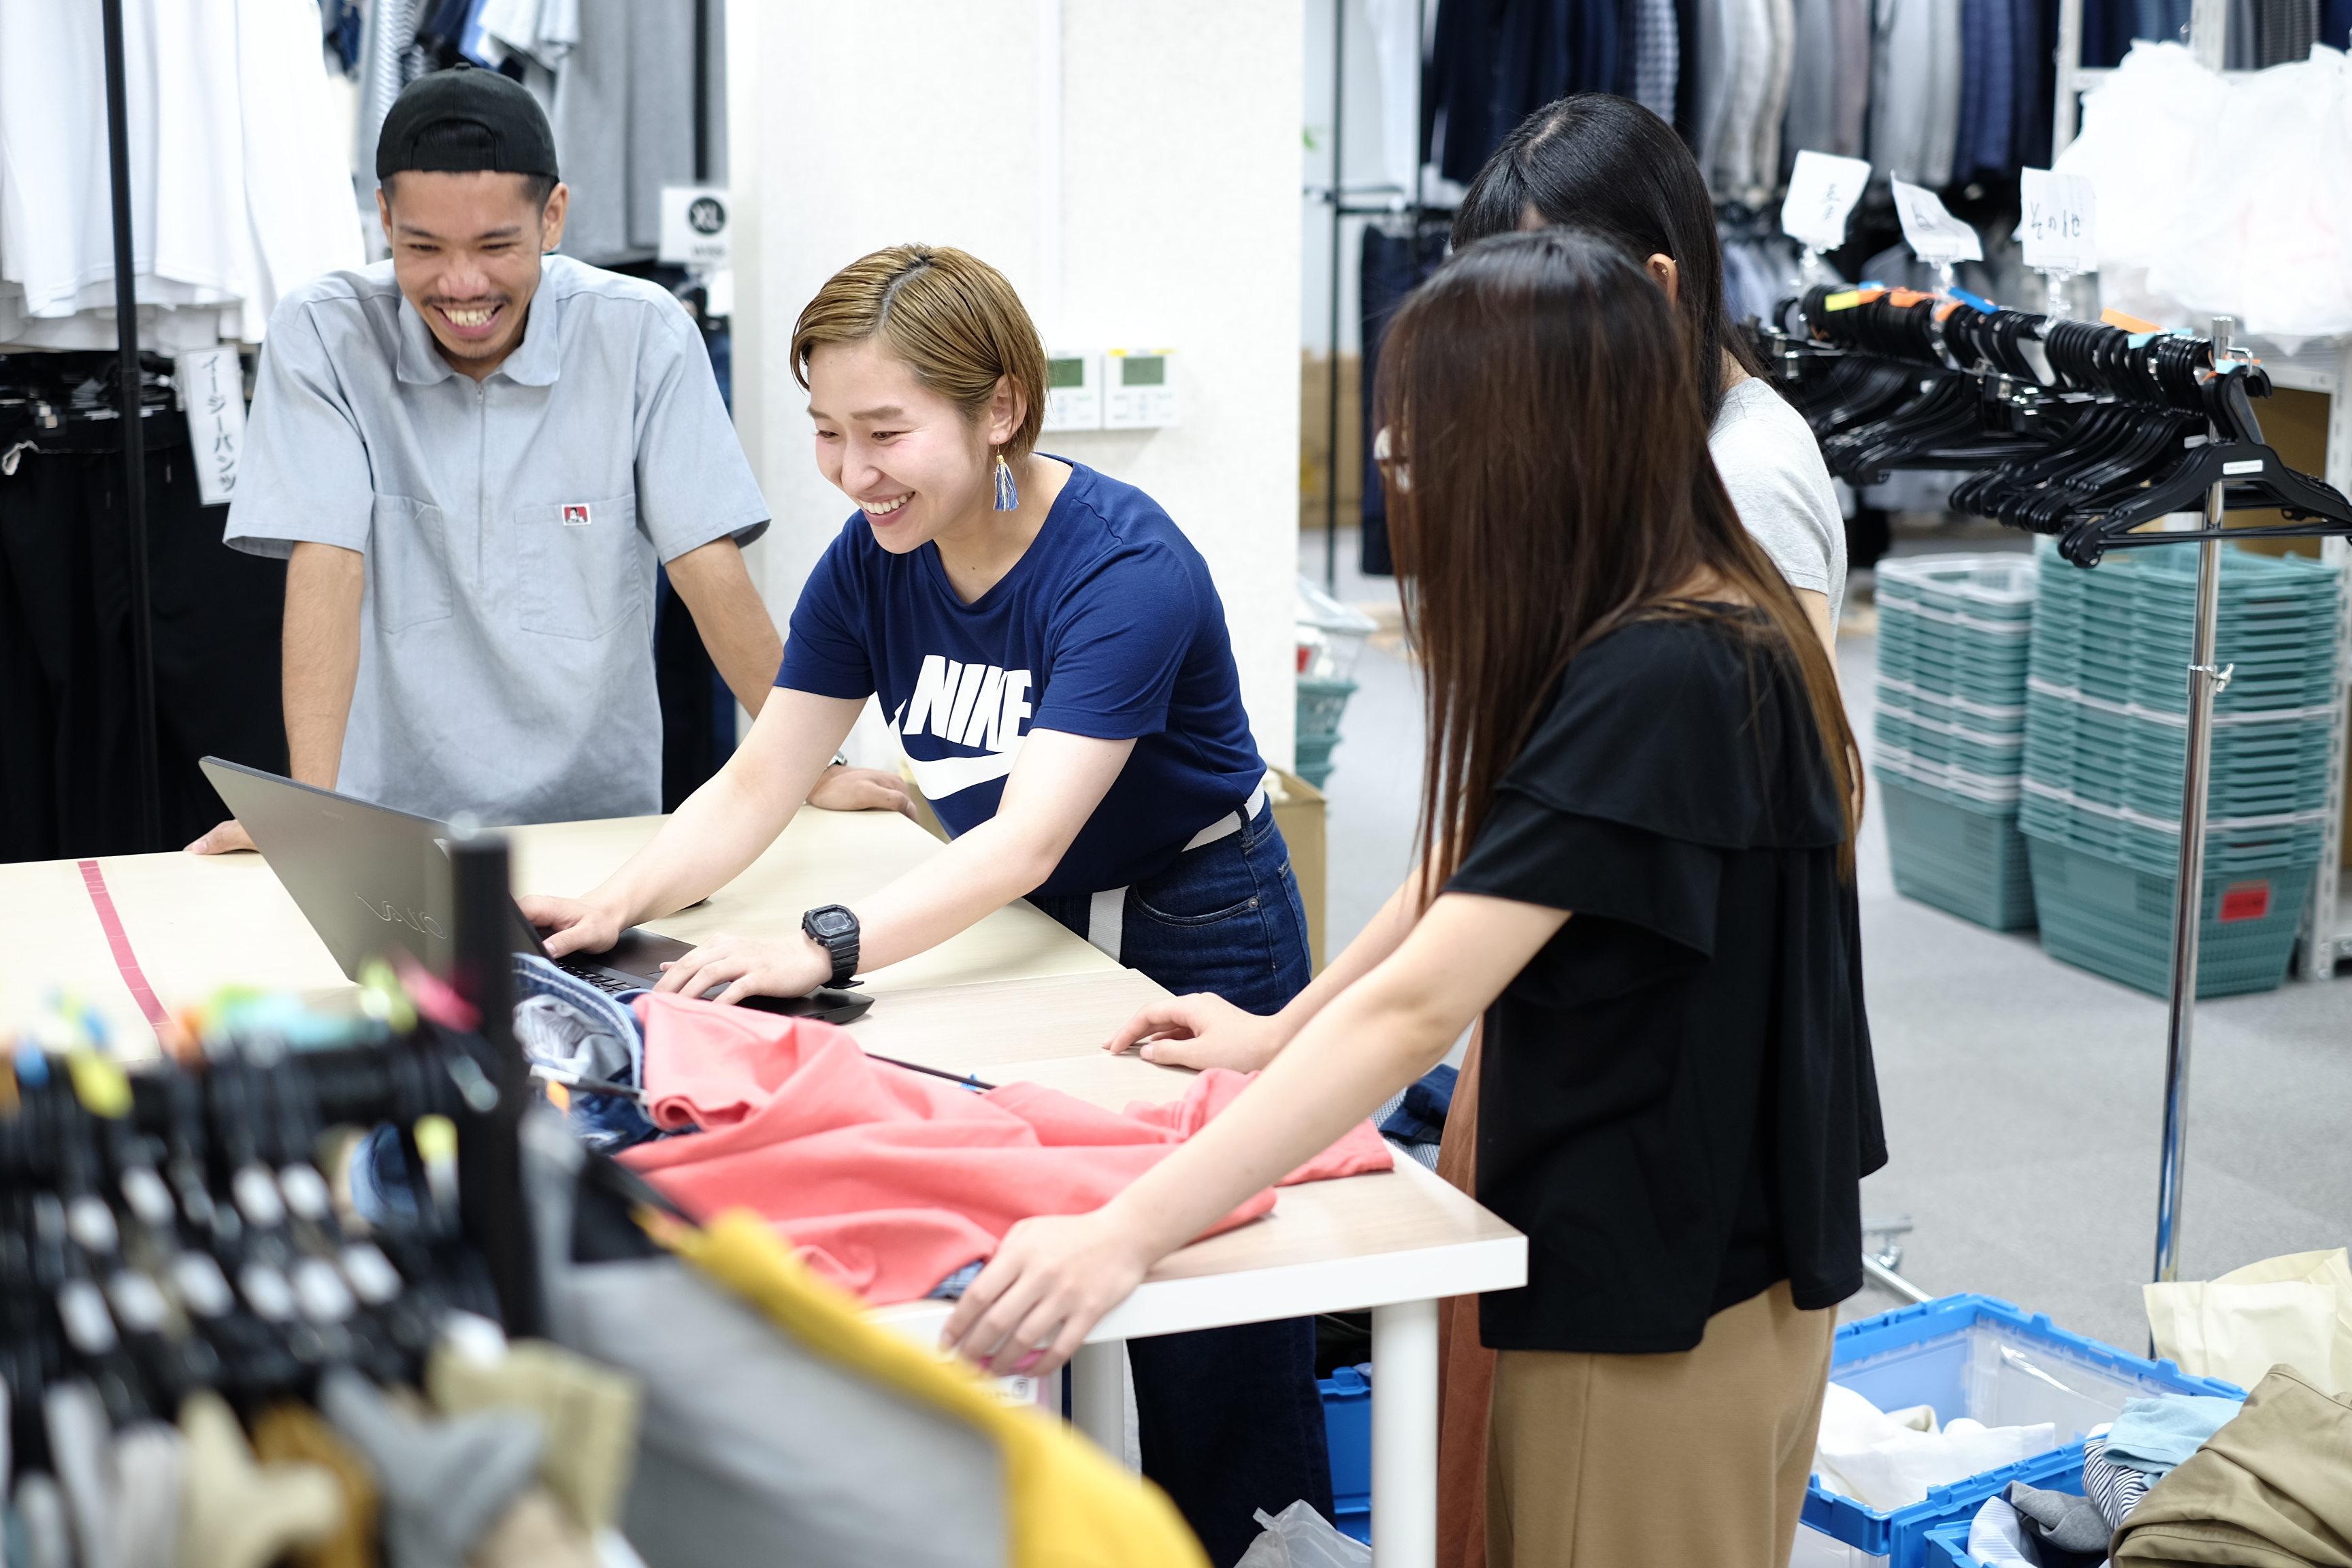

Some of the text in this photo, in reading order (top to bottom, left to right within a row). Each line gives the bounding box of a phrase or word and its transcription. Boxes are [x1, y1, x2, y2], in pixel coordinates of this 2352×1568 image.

[693, 202, 722, 230] XL
[201, 353, 237, 494] イージーパンツ
[902, 654, 1032, 753] NIKE
[354, 891, 447, 939] VAIO
